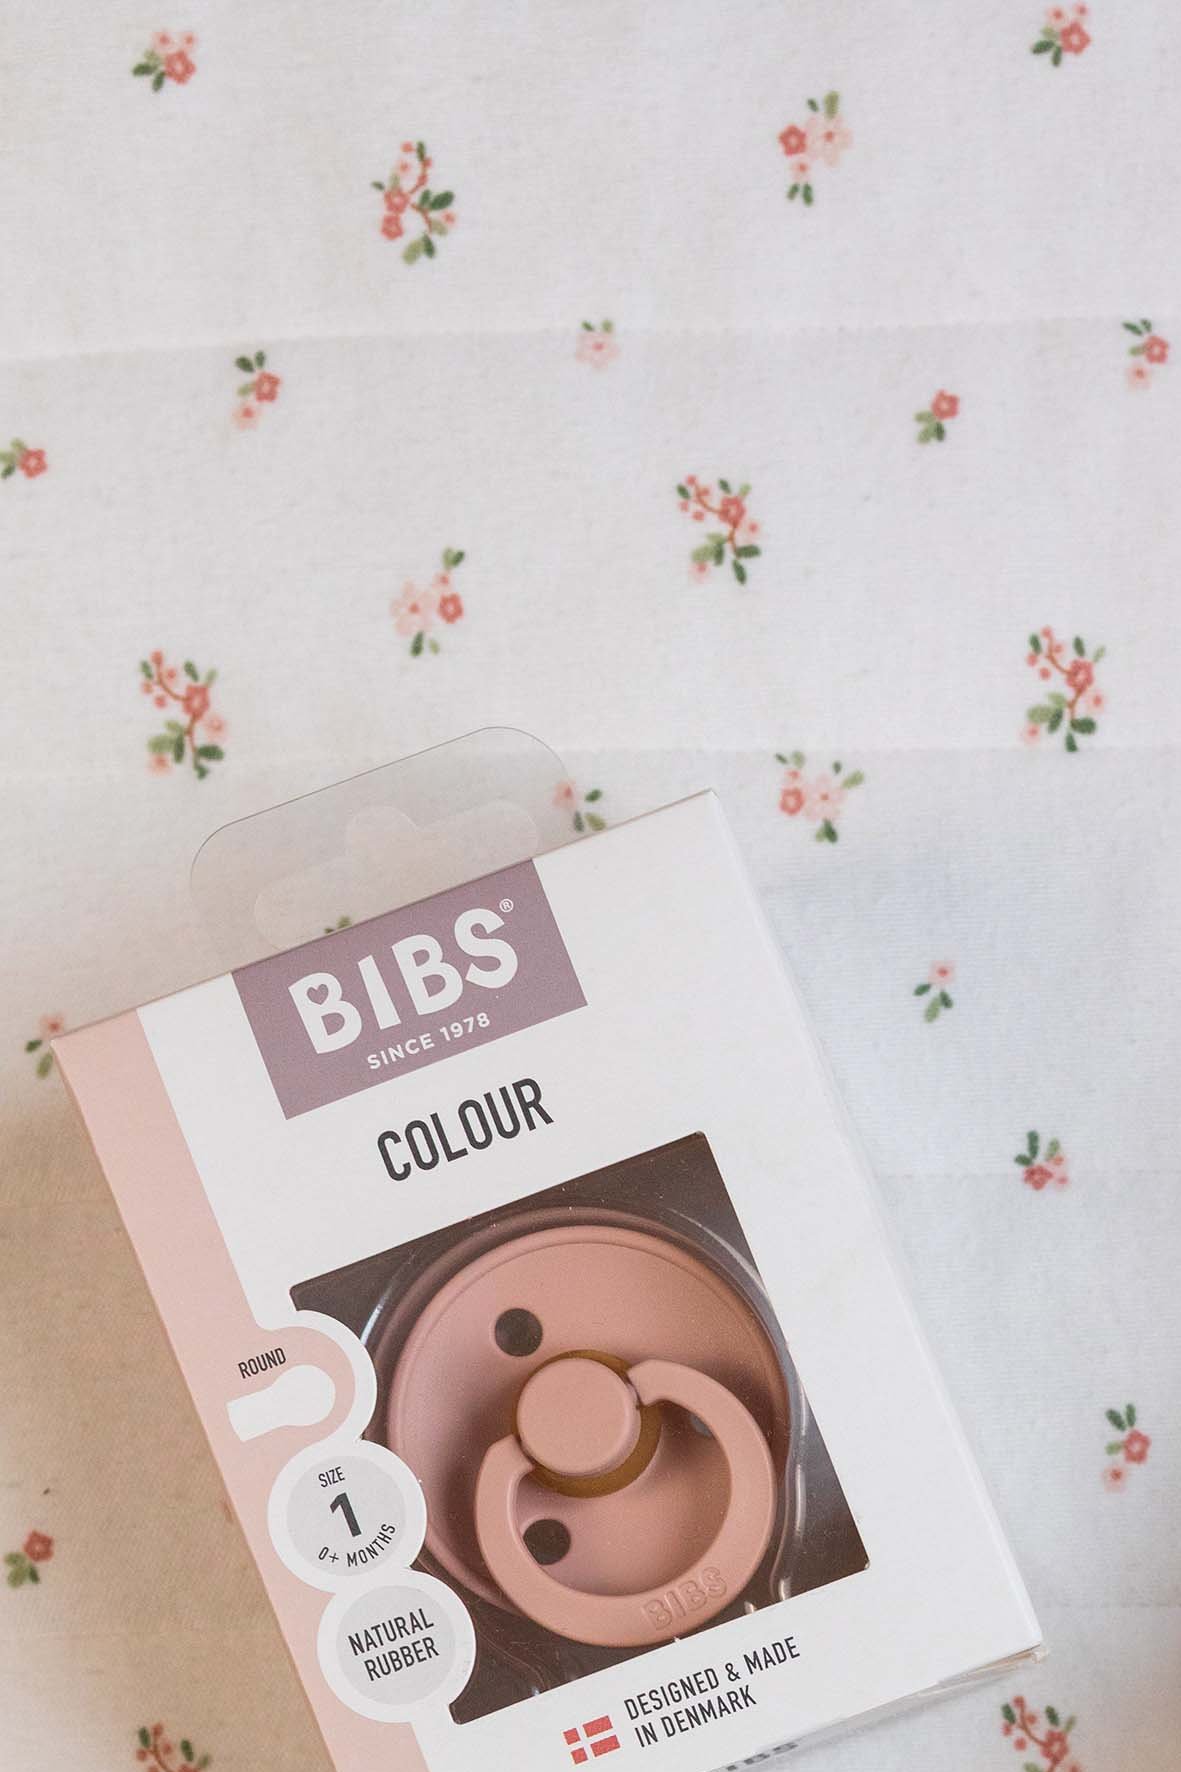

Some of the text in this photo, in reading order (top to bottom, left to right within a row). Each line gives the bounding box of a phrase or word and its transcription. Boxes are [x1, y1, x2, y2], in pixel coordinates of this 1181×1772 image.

[367, 1013, 490, 1070] SINCE 1978
[377, 1078, 554, 1181] COLOUR
[238, 1347, 286, 1379] ROUND
[318, 1466, 345, 1488] SIZE
[329, 1492, 362, 1538] 1
[318, 1523, 396, 1567] 0+ MONTHS
[641, 1566, 728, 1631] BIBS
[347, 1608, 434, 1656] NATURAL
[363, 1637, 440, 1682] RUBBER
[624, 1636, 800, 1720] DESIGNED & MADE
[634, 1685, 757, 1748] IN DENMARK
